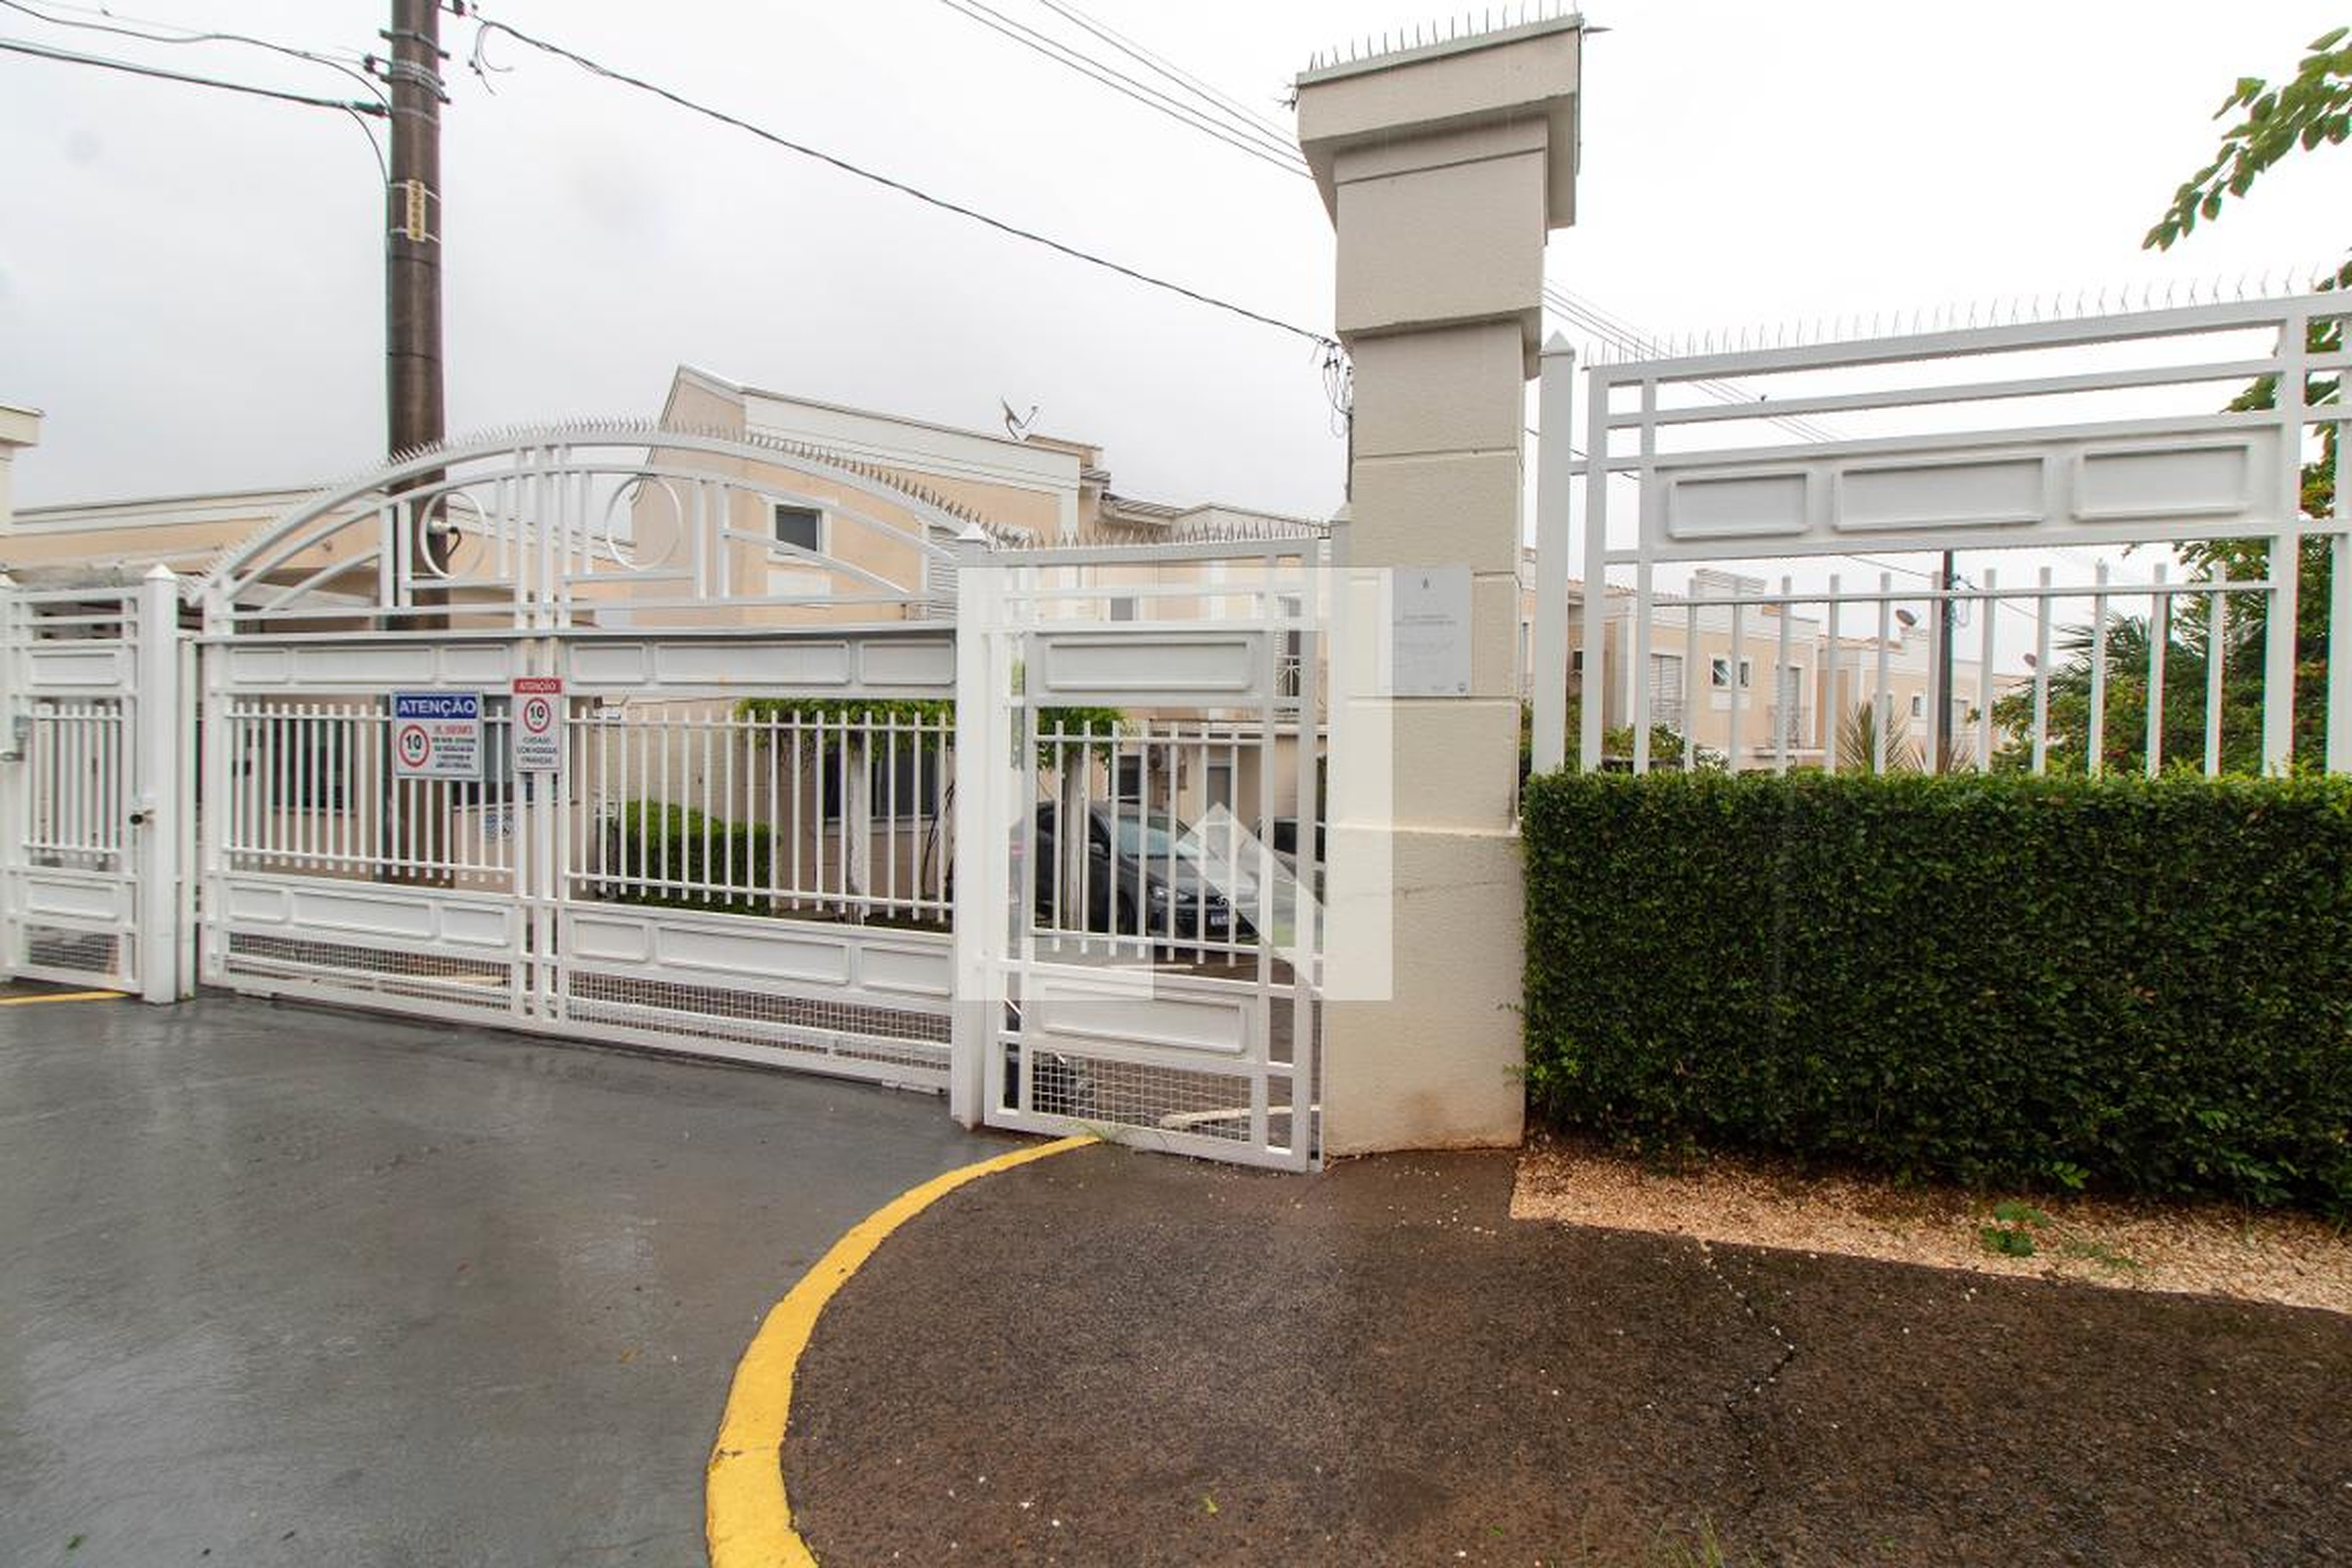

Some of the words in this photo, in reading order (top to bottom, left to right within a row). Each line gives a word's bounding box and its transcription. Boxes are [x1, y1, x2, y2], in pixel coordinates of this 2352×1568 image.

[399, 698, 476, 717] ATENÇÃO
[530, 706, 545, 718] 10
[406, 734, 422, 750] 10
